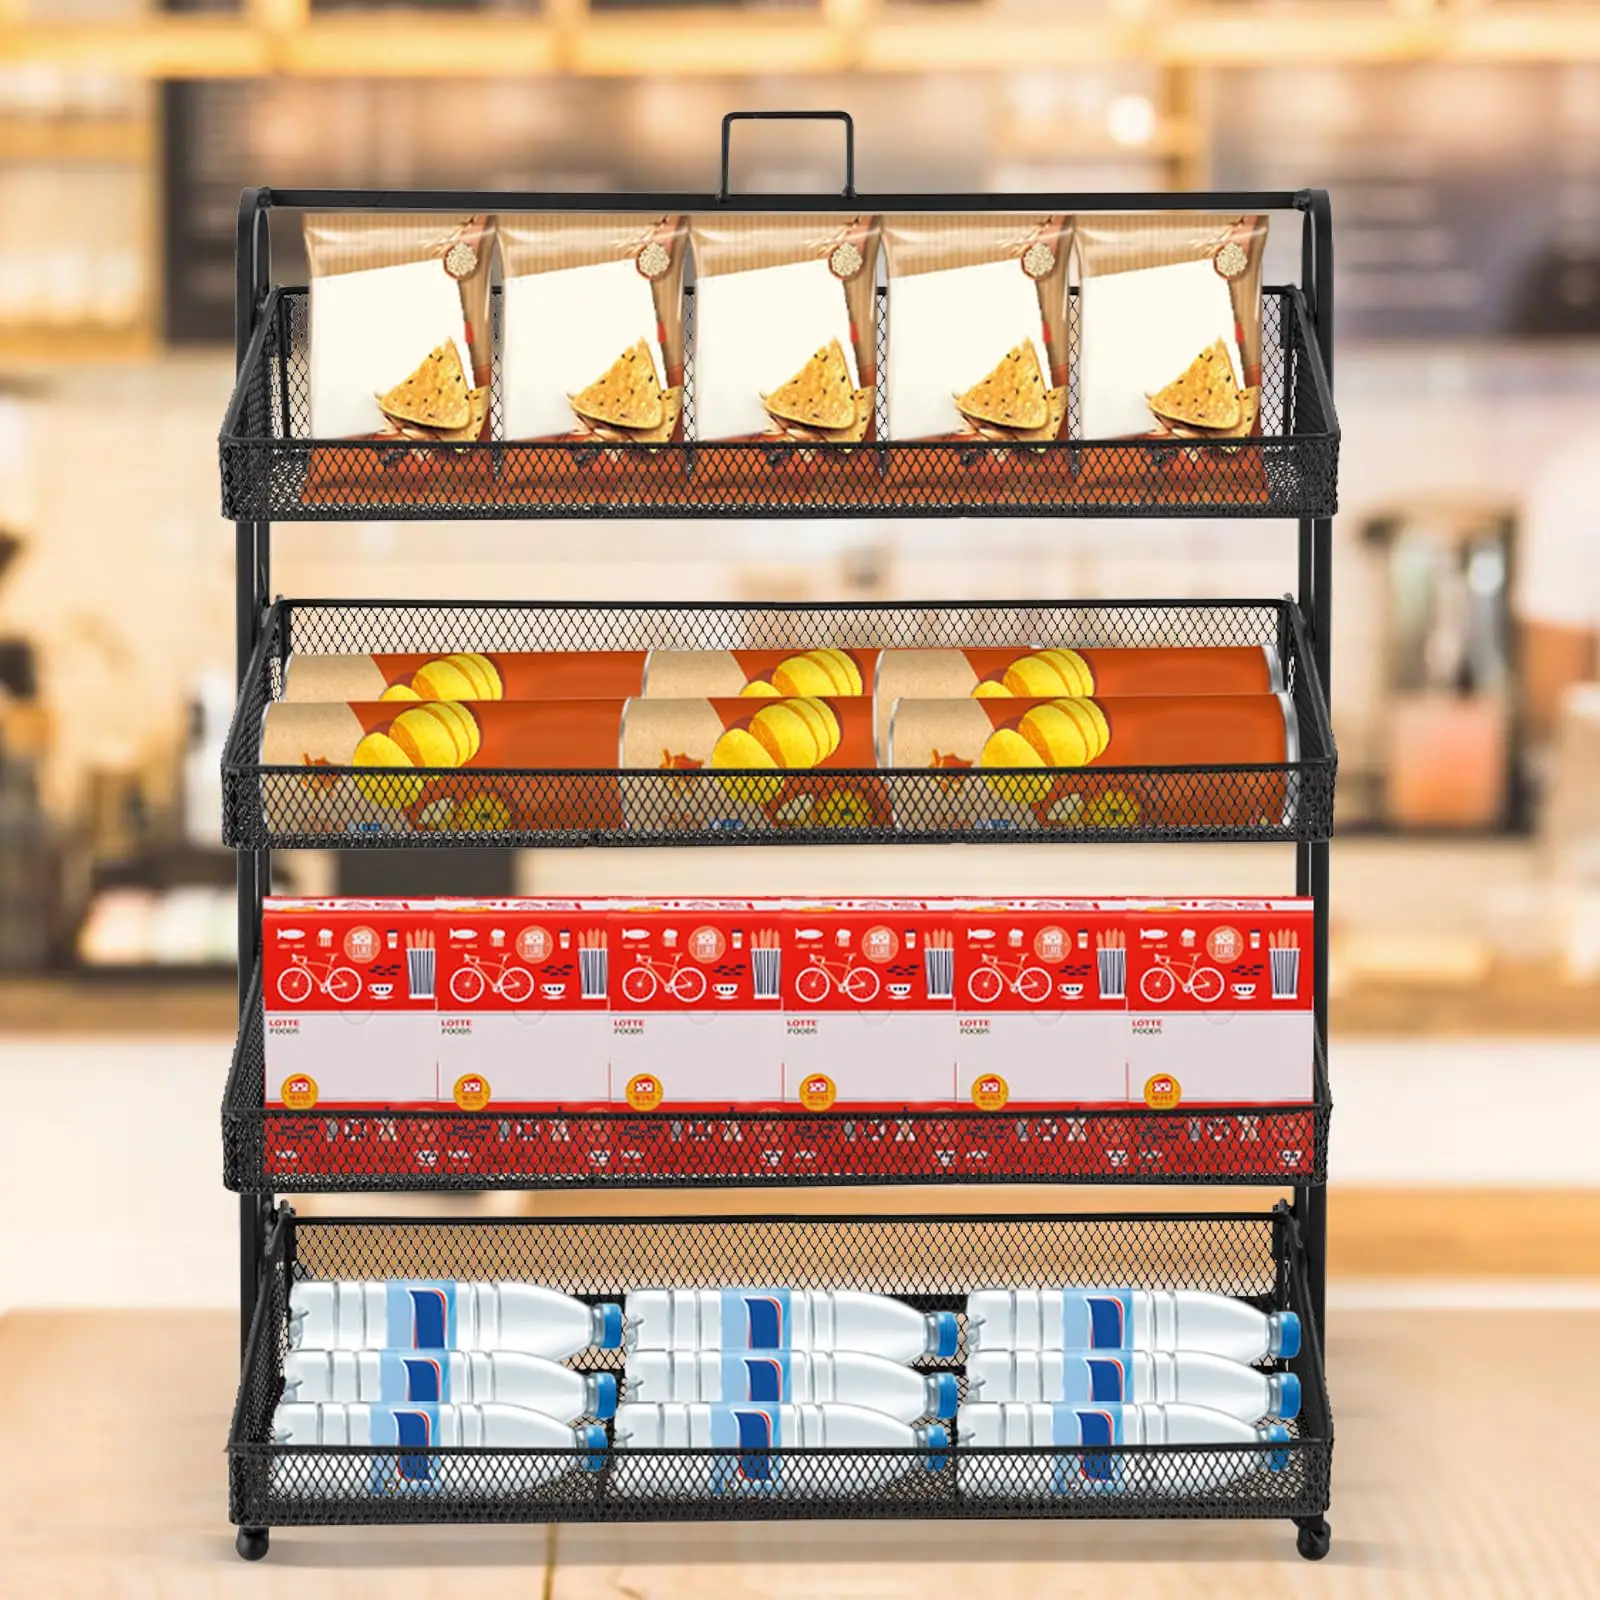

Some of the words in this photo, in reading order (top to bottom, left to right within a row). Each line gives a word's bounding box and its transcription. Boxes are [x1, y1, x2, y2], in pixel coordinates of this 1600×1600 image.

[268, 1019, 299, 1027] LOTTE
[441, 1019, 472, 1027] LOTTE
[614, 1019, 645, 1027] LOTTE
[787, 1019, 818, 1027] LOTTE
[960, 1019, 991, 1027] LOTTE
[1132, 1019, 1163, 1027] LOTTE
